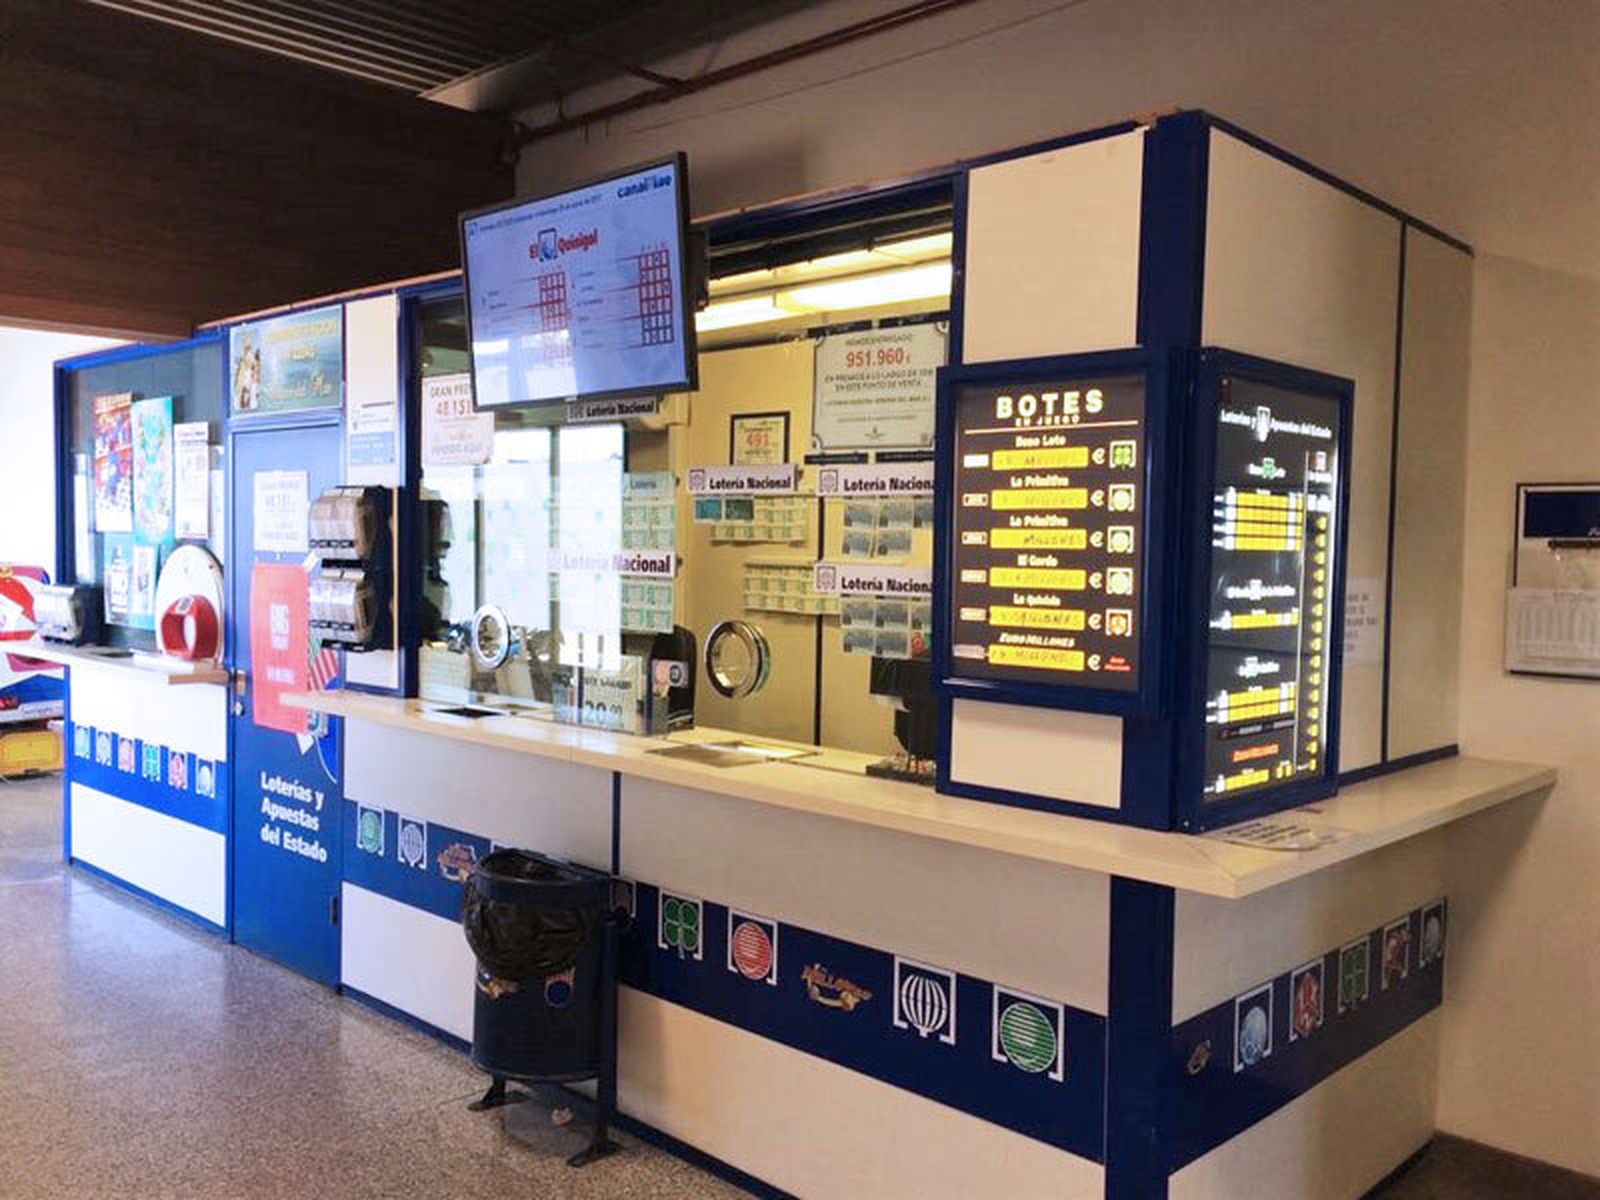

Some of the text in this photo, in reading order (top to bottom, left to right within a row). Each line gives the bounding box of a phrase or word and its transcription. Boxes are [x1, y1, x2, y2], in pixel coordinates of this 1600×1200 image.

[846, 347, 904, 368] 951.960
[618, 399, 655, 415] Nacional
[996, 389, 1104, 419] BOTES
[1043, 433, 1067, 446] Loto
[709, 471, 791, 491] Lotería Nacional
[844, 475, 934, 493] Lotería Nacion
[1024, 475, 1070, 487] Primitiva
[1024, 515, 1069, 527] Primitiva
[611, 553, 672, 574] Nacional
[1029, 555, 1059, 567] Gordo
[841, 574, 932, 592] Lotería Nacion
[261, 772, 325, 812] Loterías y
[261, 797, 320, 831] Apuestas
[261, 824, 328, 864] del Estado
